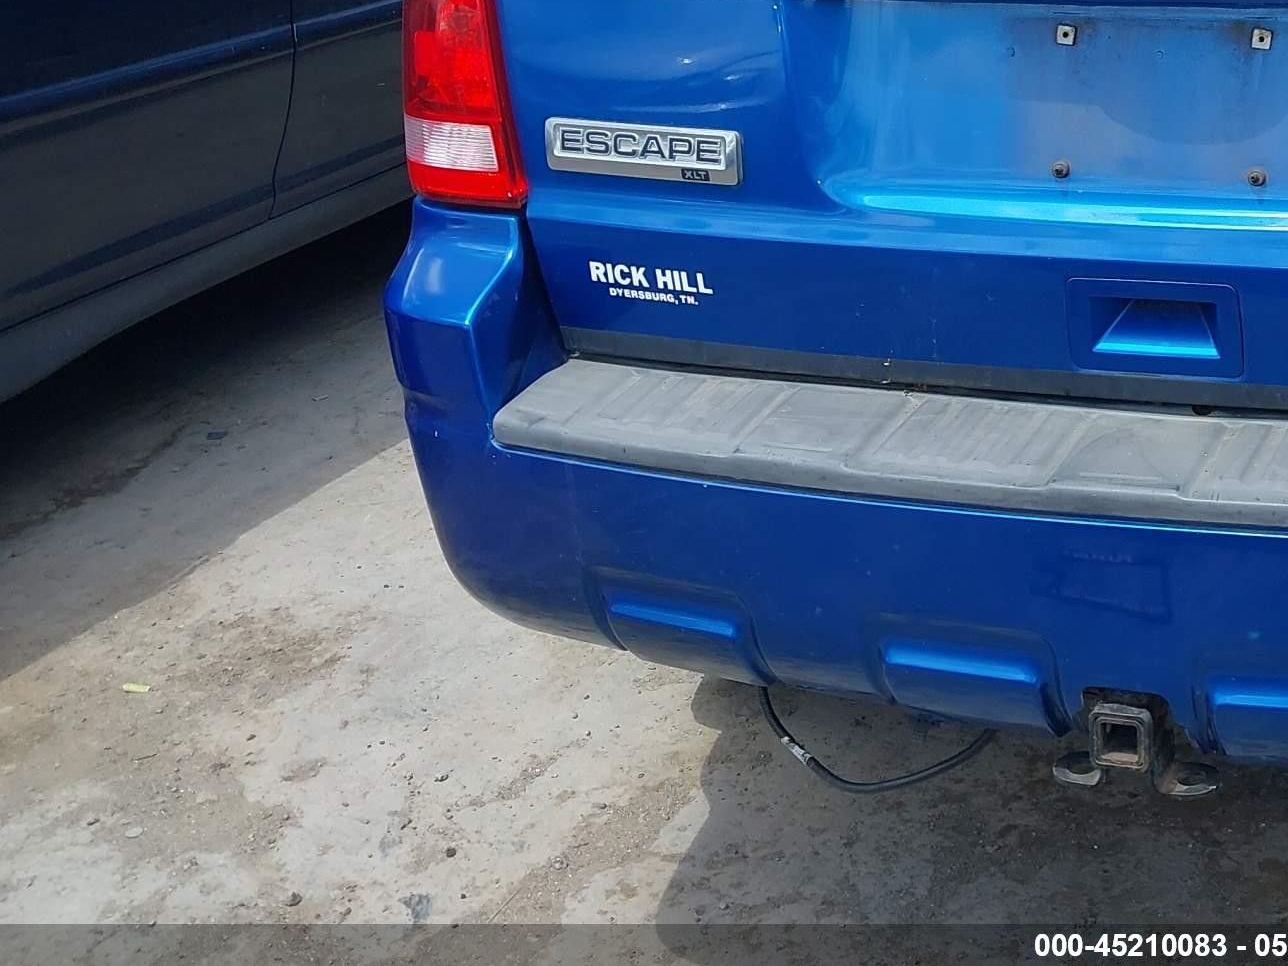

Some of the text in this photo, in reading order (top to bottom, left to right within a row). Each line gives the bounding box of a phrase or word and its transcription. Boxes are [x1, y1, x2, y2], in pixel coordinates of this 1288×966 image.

[559, 126, 722, 165] ESCAPE
[684, 170, 708, 180] XLT
[589, 261, 714, 295] RICK HILL
[609, 287, 699, 305] DYERSBURG, TN.
